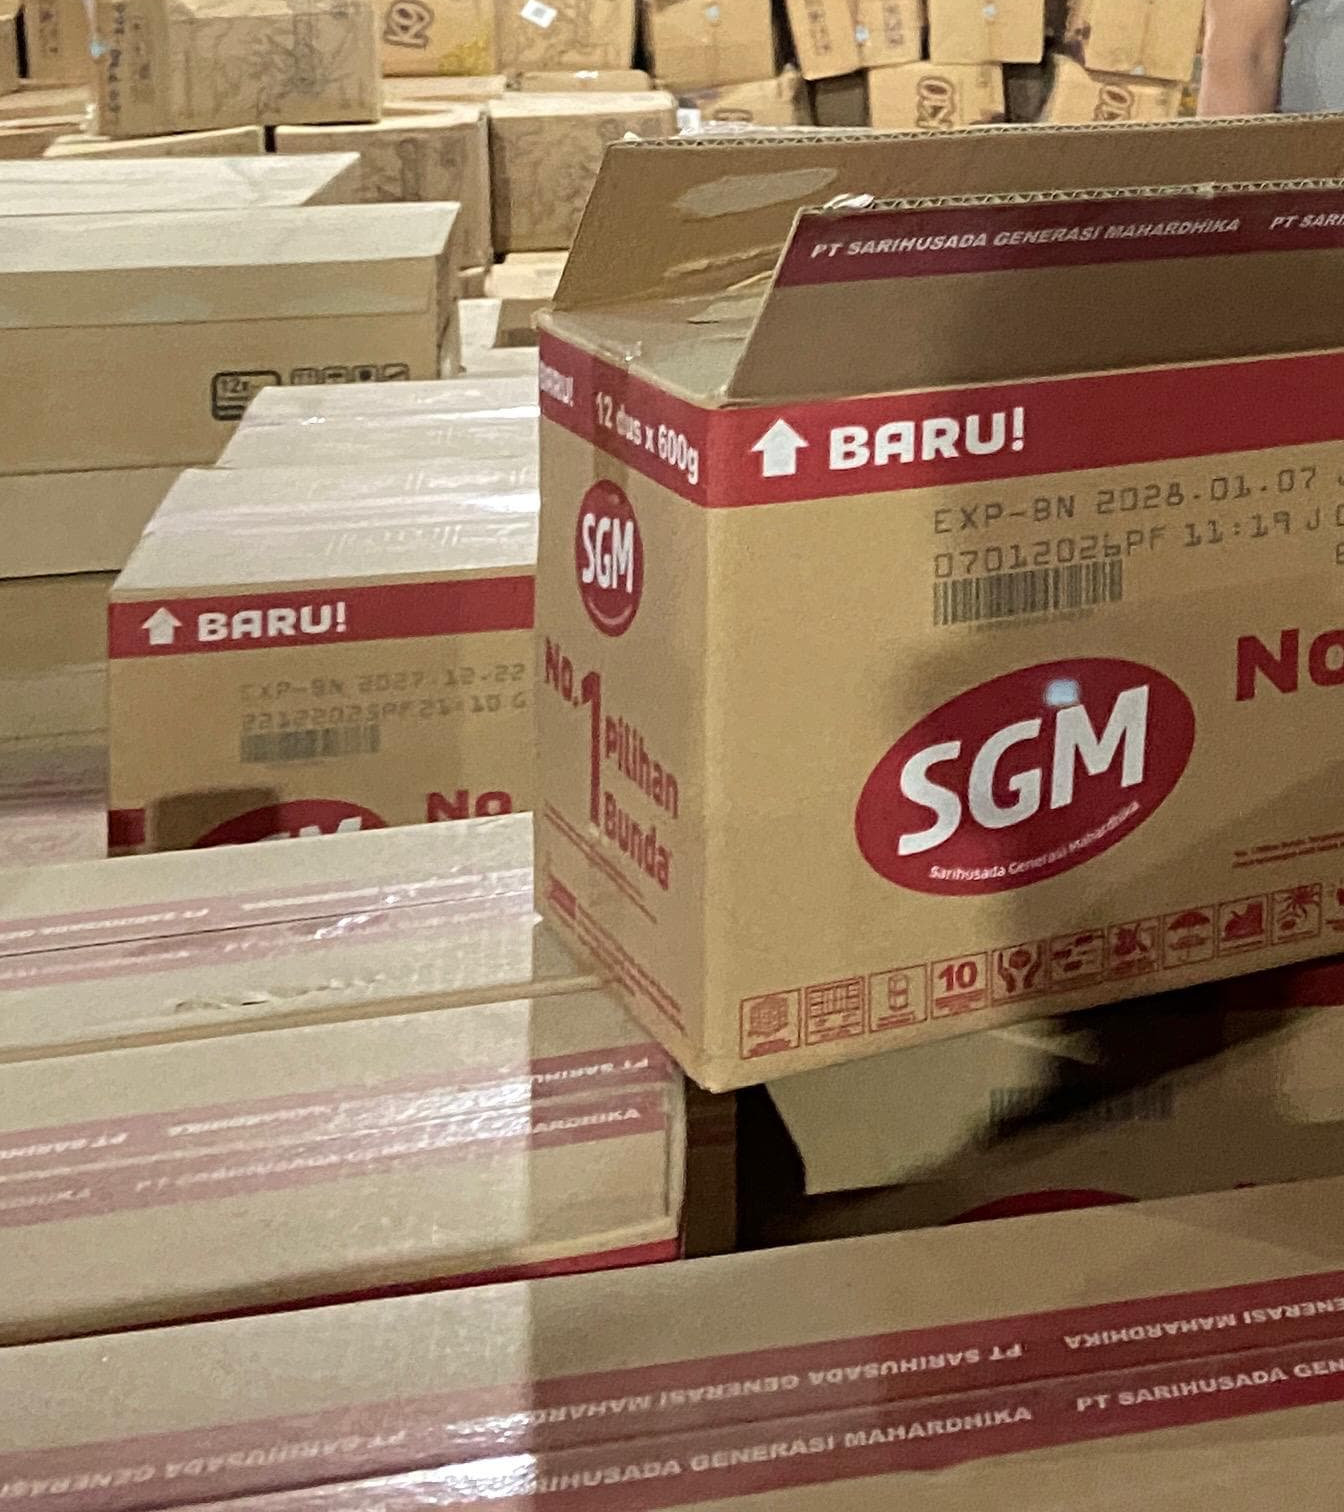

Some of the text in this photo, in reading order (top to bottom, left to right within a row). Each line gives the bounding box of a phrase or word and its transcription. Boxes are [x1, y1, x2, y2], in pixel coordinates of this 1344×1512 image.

[811, 216, 1242, 258] PT SARIHUSADA GENERASI MAHARDHIKA
[1270, 216, 1294, 230] PT
[596, 391, 614, 429] 12
[658, 423, 699, 485] 600g
[828, 406, 1025, 471] BARU!
[1184, 509, 1292, 548] 11:19
[582, 512, 635, 594] SGM
[197, 601, 348, 643] BARU!
[544, 636, 679, 827] No. 1 Pilihan
[897, 685, 1150, 856] SGM
[603, 790, 670, 892] Bunda
[929, 863, 1006, 881] Sarihusada
[938, 961, 978, 991] 10
[1064, 1310, 1239, 1351] MAHARDHIKA
[807, 1348, 982, 1385] SARIHUSADA
[988, 1343, 1024, 1362] PT
[659, 1373, 801, 1410] GENERASI
[1075, 1392, 1112, 1413] PT
[1117, 1365, 1289, 1408] SARIHUSADA
